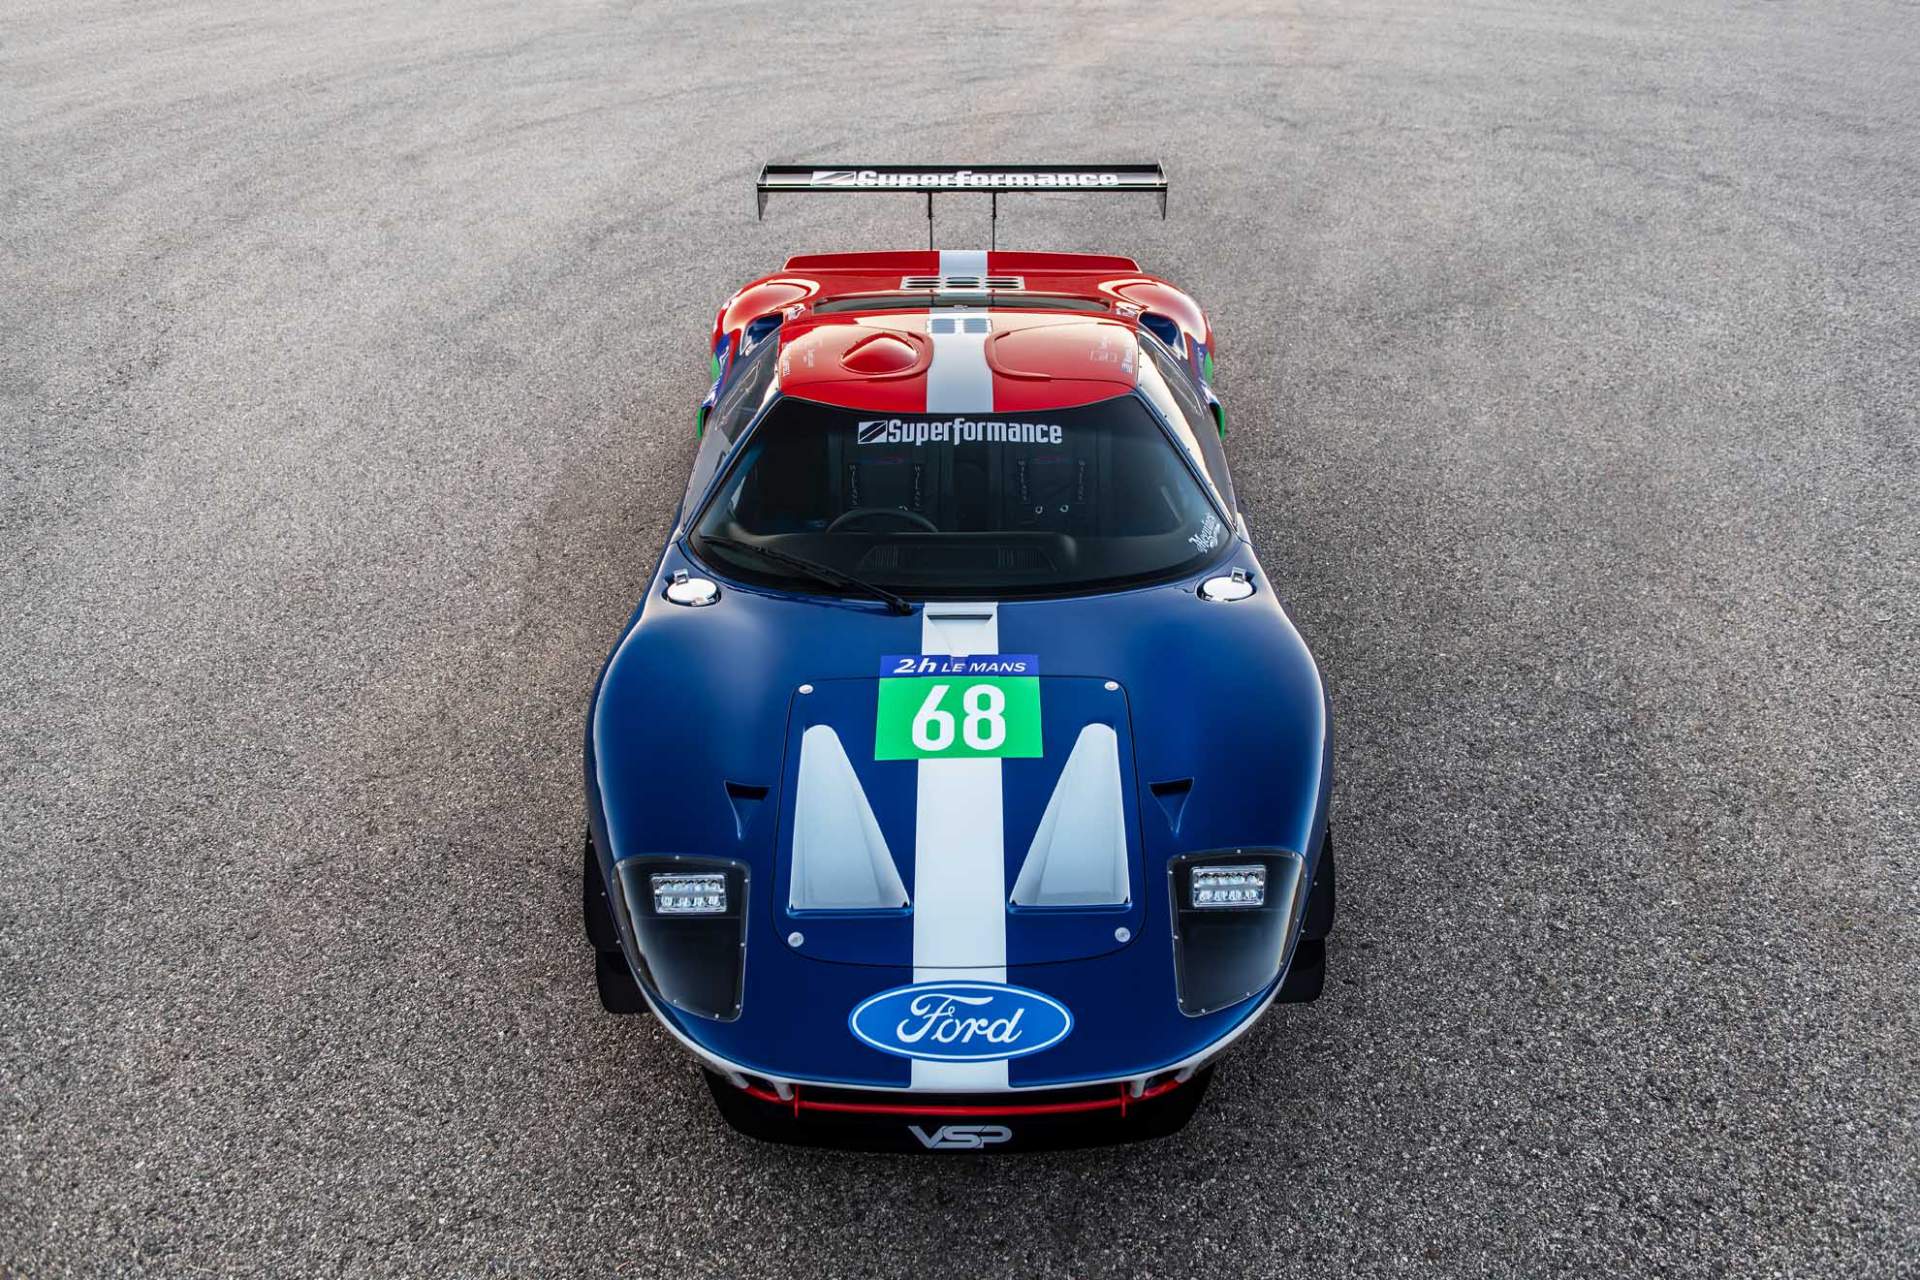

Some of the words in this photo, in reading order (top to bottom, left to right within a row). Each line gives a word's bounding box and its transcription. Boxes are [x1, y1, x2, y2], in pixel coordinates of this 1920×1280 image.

[857, 170, 1120, 187] Superformance
[888, 418, 1063, 446] Superformance
[941, 662, 965, 673] LE
[969, 662, 1027, 673] MANS
[911, 684, 1006, 752] 68
[896, 993, 1025, 1044] Ford
[908, 1125, 1013, 1149] VSP
